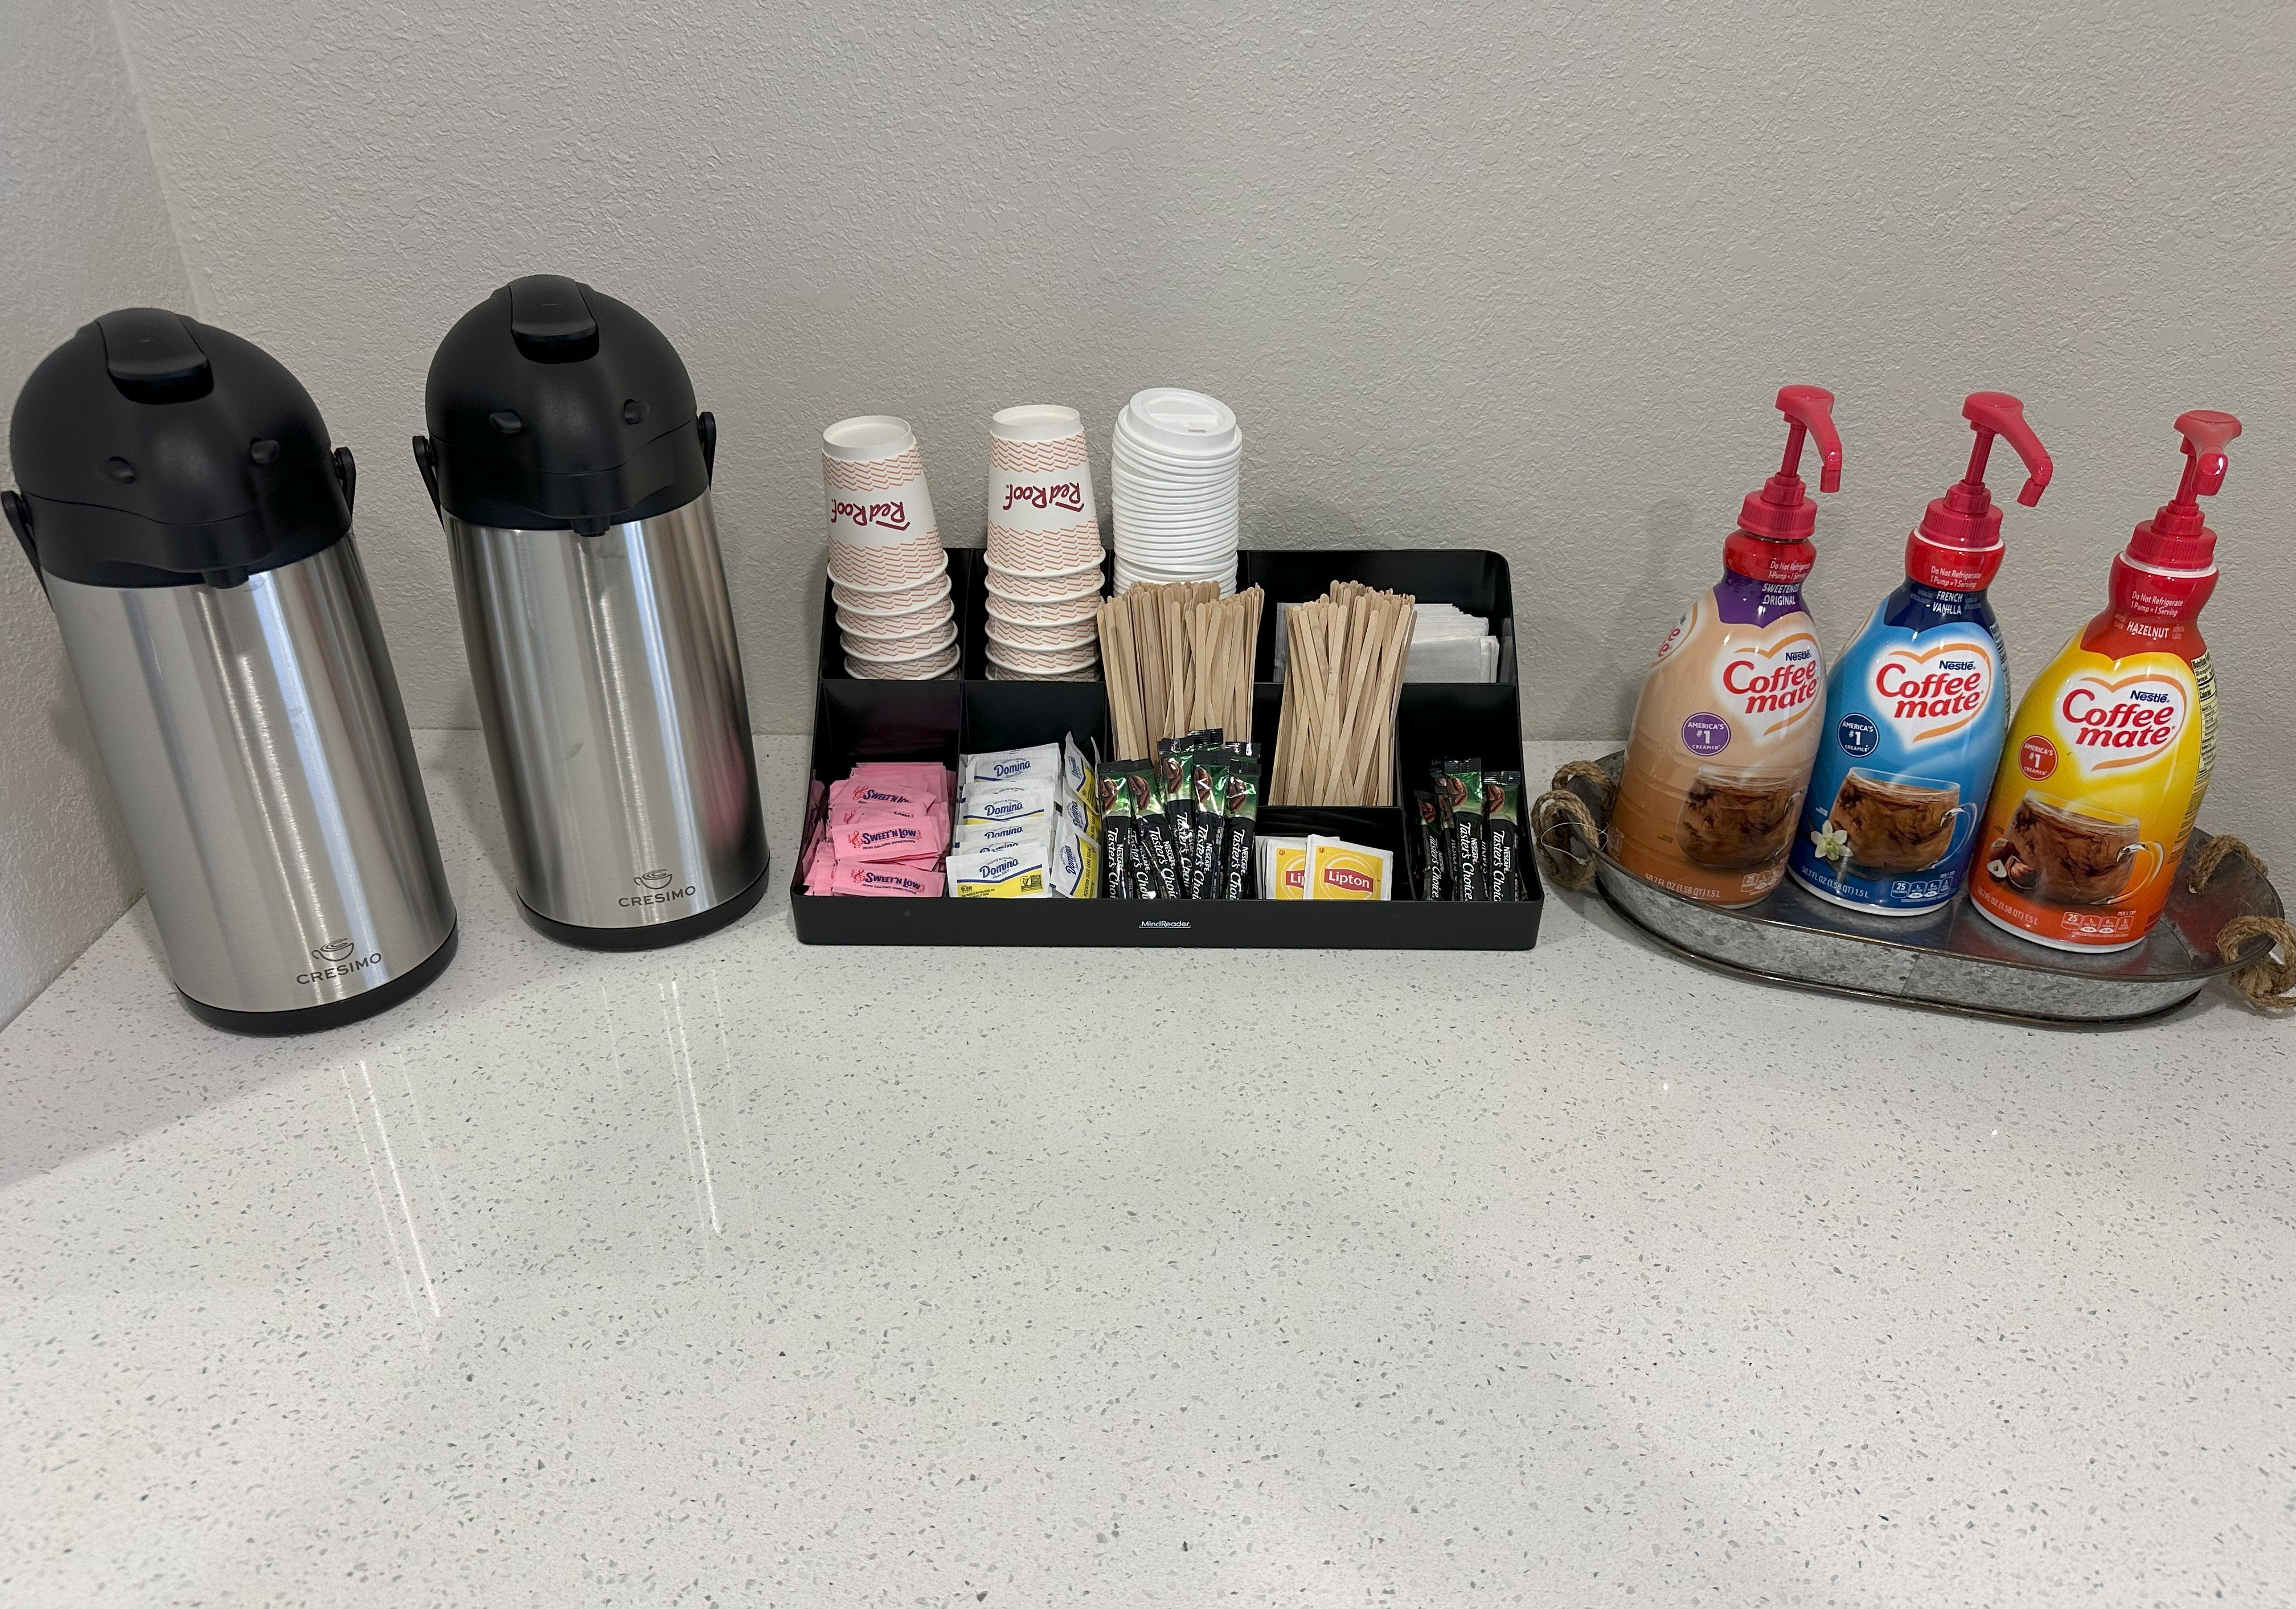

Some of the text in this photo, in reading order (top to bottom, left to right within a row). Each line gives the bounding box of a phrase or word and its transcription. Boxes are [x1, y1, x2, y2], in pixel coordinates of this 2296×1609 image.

[1049, 482, 1081, 504] Red
[870, 501, 905, 523] Red
[1934, 576, 1949, 587] Pump
[1957, 580, 1977, 589] Serving
[1951, 570, 1982, 580] Refrigerate
[1764, 594, 1795, 606] ORIGINAL
[1936, 590, 1963, 602] FRENCH
[2132, 590, 2183, 607] Do Not Refrigerate
[1933, 602, 1962, 615] VANILLA
[2134, 602, 2149, 614] Pump
[2158, 606, 2179, 618] Serving
[2126, 621, 2170, 638] HAZELNUT
[1723, 660, 1816, 695] Coffee
[1876, 663, 1981, 699] Coffee
[1745, 678, 1817, 714] mate
[1895, 692, 1980, 719] mate
[2063, 688, 2174, 728] Coffee
[1688, 721, 1724, 730] AMERICA'S
[1842, 721, 1873, 732] AMERICA'S
[1696, 730, 1710, 744] #1
[1848, 730, 1860, 745] #1
[2075, 726, 2171, 748] mate
[2024, 742, 2053, 756] AMERICA'S
[994, 761, 1031, 777] Domino
[2029, 752, 2040, 768] #1
[984, 802, 1023, 816] Domino
[1108, 827, 1118, 869] Taster's
[1130, 830, 1142, 868] Taster's
[1149, 826, 1168, 864] Taster's
[1196, 824, 1208, 867] Taster's
[1231, 829, 1245, 869] Taster's
[1493, 830, 1505, 868] Taster's
[979, 858, 1018, 879] Domino
[1064, 844, 1076, 876] Domino
[1459, 822, 1474, 901] Taster's Choice
[1329, 871, 1370, 888] Lipton
[1645, 873, 1658, 883] 507
[1658, 879, 1665, 887] FL
[1666, 881, 1676, 890] OZ
[1694, 888, 1705, 897] QT)
[1812, 872, 1818, 881] FL
[1819, 875, 1827, 884] OZ
[1843, 885, 1854, 894] QT)
[618, 886, 696, 907] CRESIMO
[1991, 897, 1999, 906] OZ
[297, 953, 382, 984] CRESIMO
